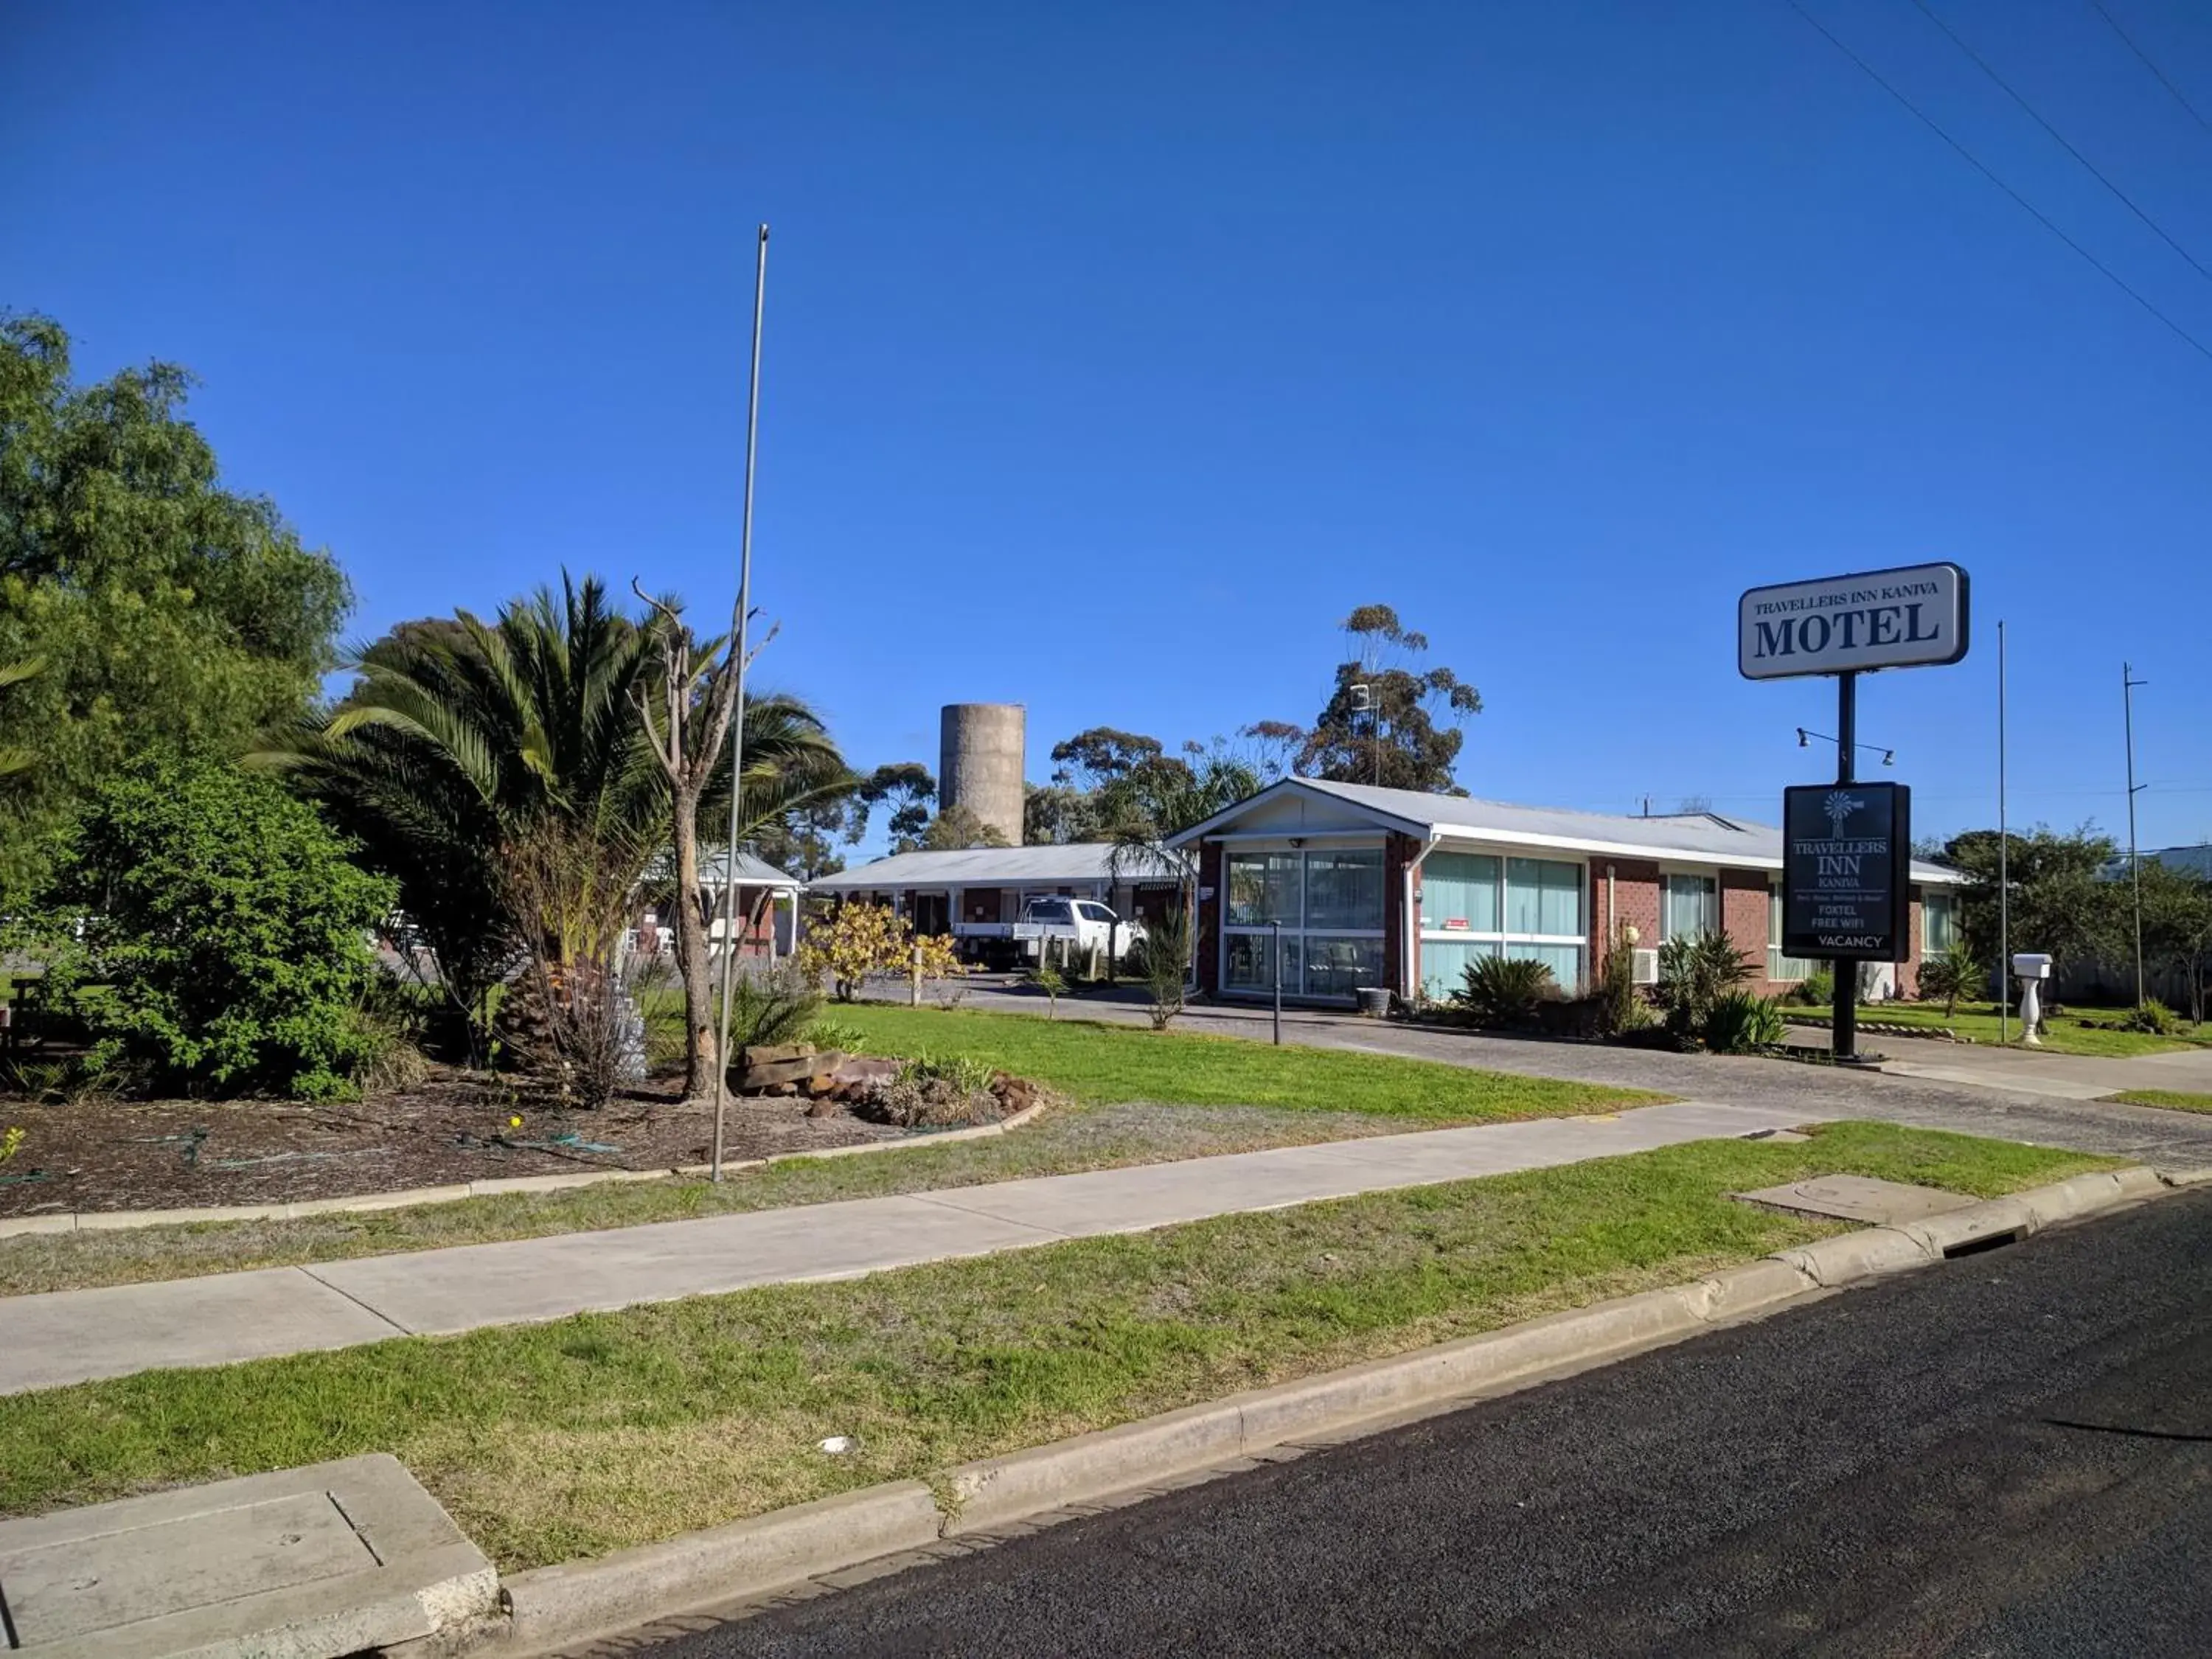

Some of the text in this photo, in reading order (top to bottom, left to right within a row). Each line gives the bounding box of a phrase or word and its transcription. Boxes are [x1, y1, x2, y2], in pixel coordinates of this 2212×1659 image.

[1754, 582, 1938, 615] TRAVELLERS INN KANIVA
[1753, 603, 1939, 658] MOTEL
[1793, 841, 1887, 855] TRAVELLERS
[1817, 855, 1861, 875] INN
[1818, 877, 1860, 888] KANIVA
[1818, 905, 1857, 915] FOXTEL
[1812, 917, 1838, 928] FREE
[1818, 935, 1882, 948] VACANCY
